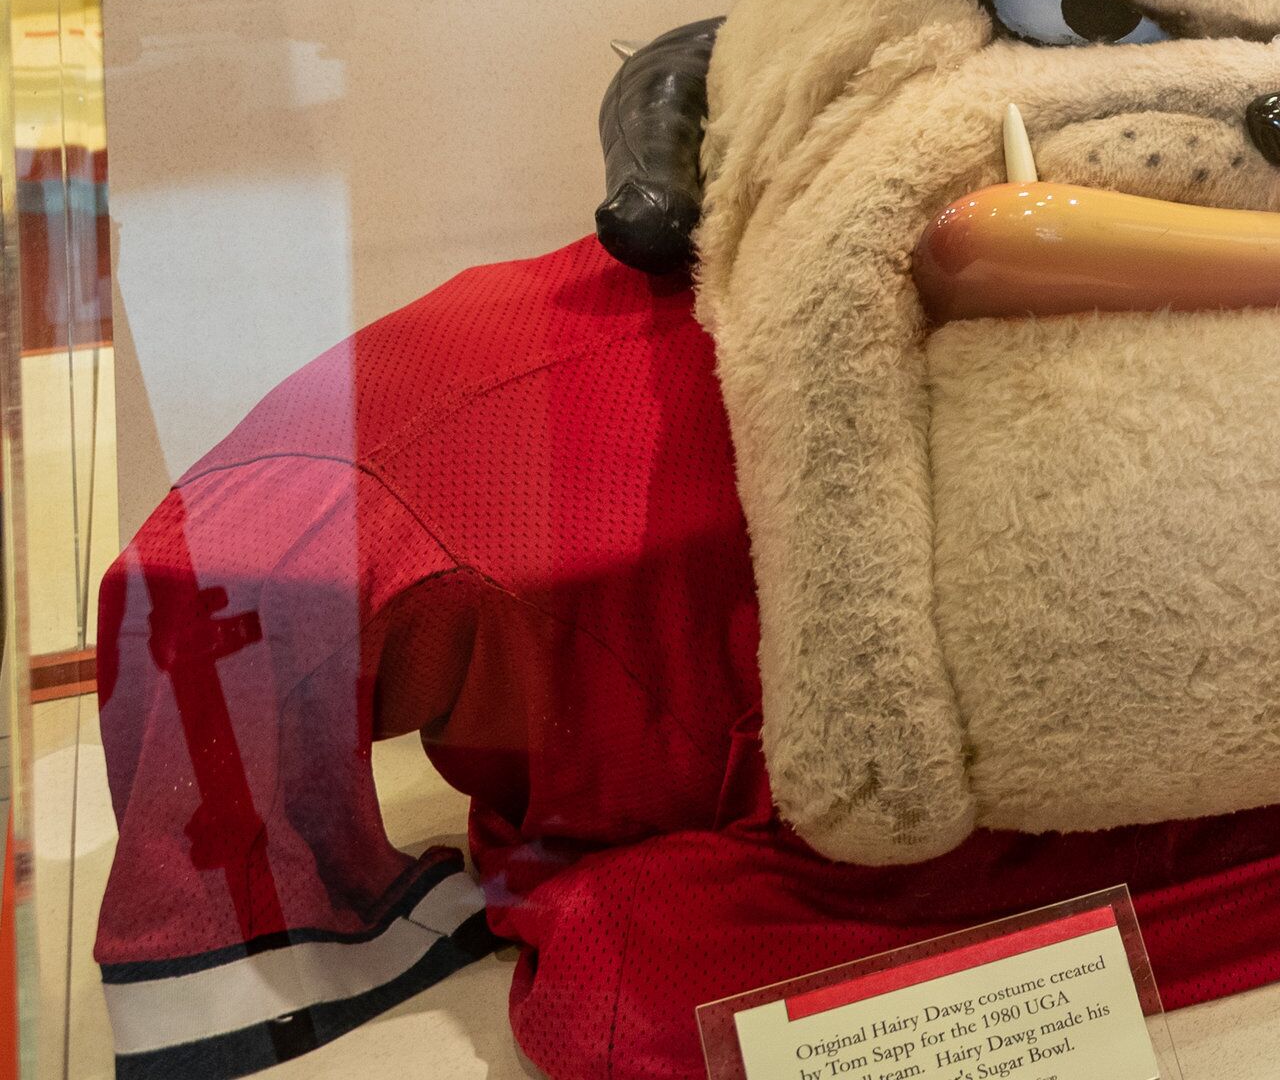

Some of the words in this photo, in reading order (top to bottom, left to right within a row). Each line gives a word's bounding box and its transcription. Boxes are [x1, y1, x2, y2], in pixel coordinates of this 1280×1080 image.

[795, 1027, 868, 1061] Original
[871, 1015, 919, 1039] Hairy
[923, 1000, 975, 1023] Dawg
[978, 976, 1046, 1007] costume
[1049, 955, 1106, 984] created
[825, 1056, 868, 1078] Tom
[872, 1041, 916, 1064] Sapp
[920, 1030, 947, 1050] for
[950, 1021, 978, 1040] the
[981, 1005, 1022, 1029] 1980
[1023, 990, 1071, 1014] UGA
[879, 1064, 925, 1080] team.
[935, 1045, 983, 1069] Hairy
[987, 1030, 1037, 1053] Dawg
[1040, 1013, 1084, 1035] made
[1087, 1002, 1111, 1020] his
[977, 1057, 1024, 1080] Sugar
[1029, 1038, 1076, 1064] Bowl.
